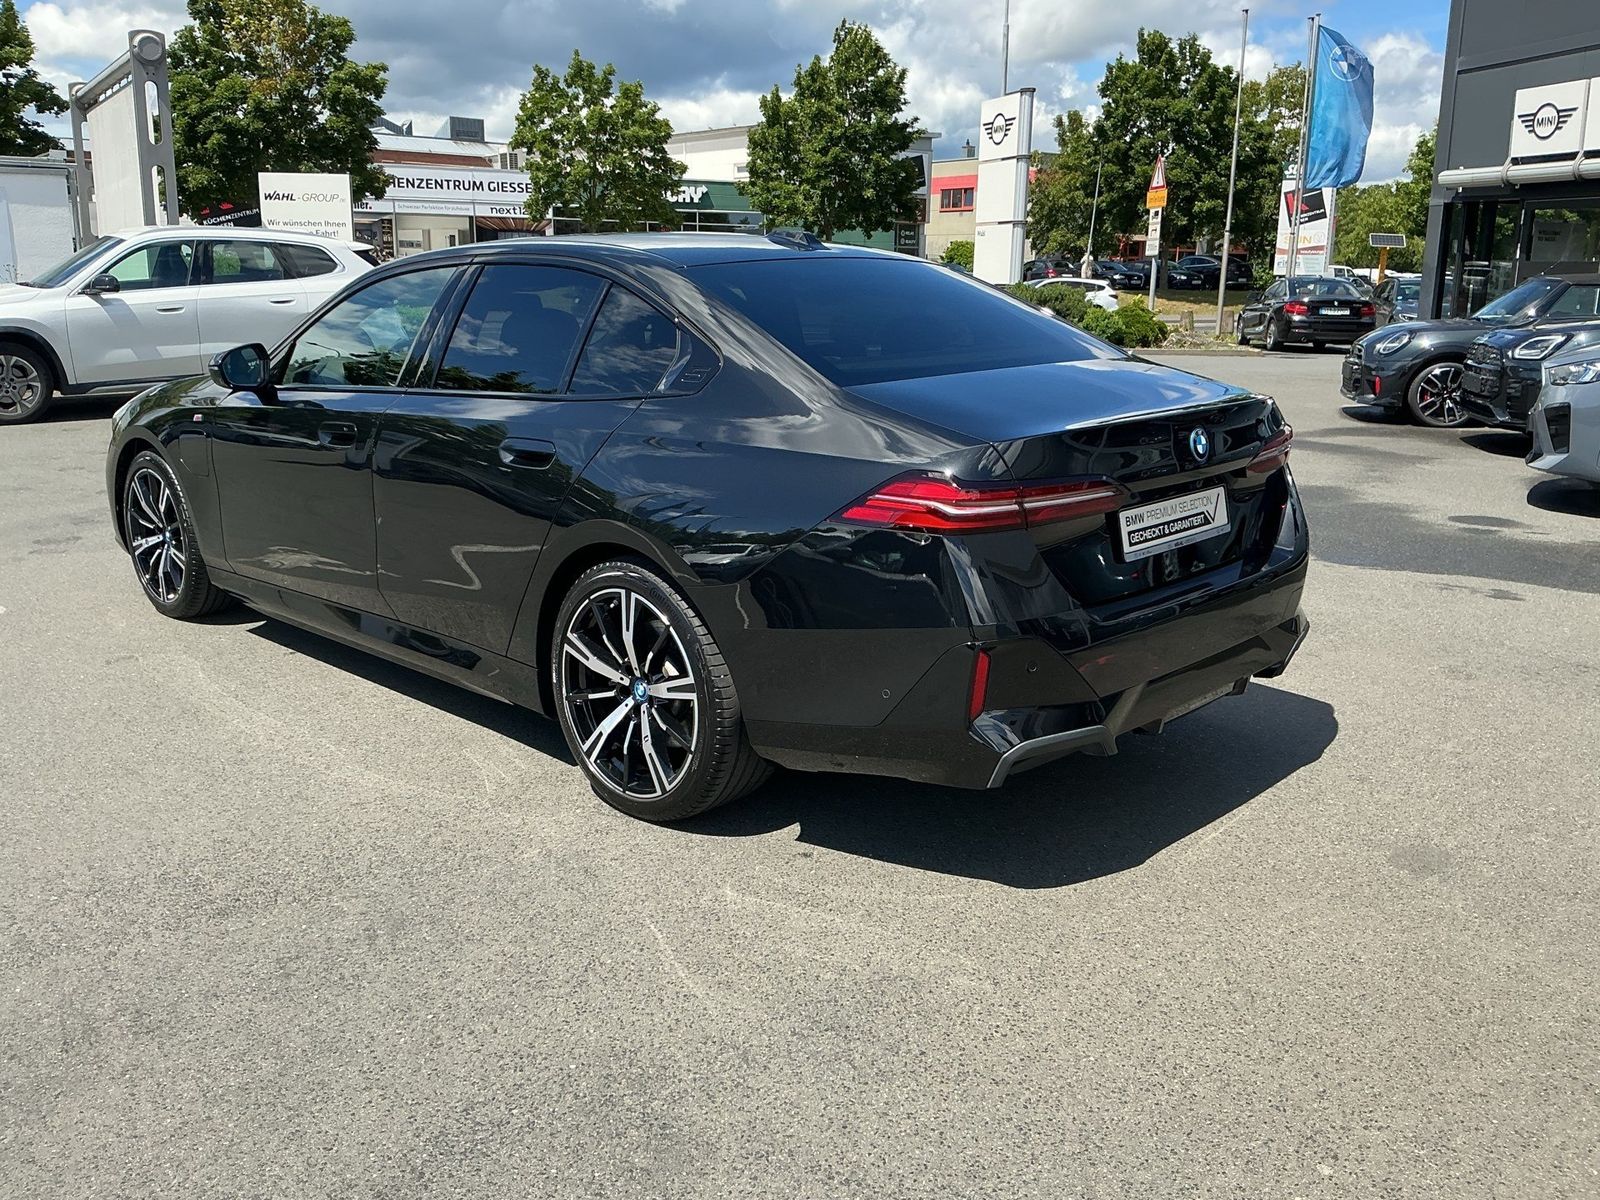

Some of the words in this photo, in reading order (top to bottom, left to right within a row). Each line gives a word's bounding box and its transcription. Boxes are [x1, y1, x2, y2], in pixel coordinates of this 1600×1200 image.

[1536, 115, 1556, 129] MINI
[264, 190, 296, 201] WAHL
[301, 193, 339, 202] GROUP
[202, 208, 260, 226] KÜCHENZENTRUM
[267, 219, 280, 227] Wir
[281, 218, 323, 228] wünschen
[324, 219, 347, 228] Ihnen
[1125, 512, 1145, 527] BMW
[1146, 503, 1178, 520] PREMIUM
[1129, 526, 1164, 544] GECHECKT
[1164, 524, 1170, 534] &
[1169, 513, 1206, 533] GARANTIERT
